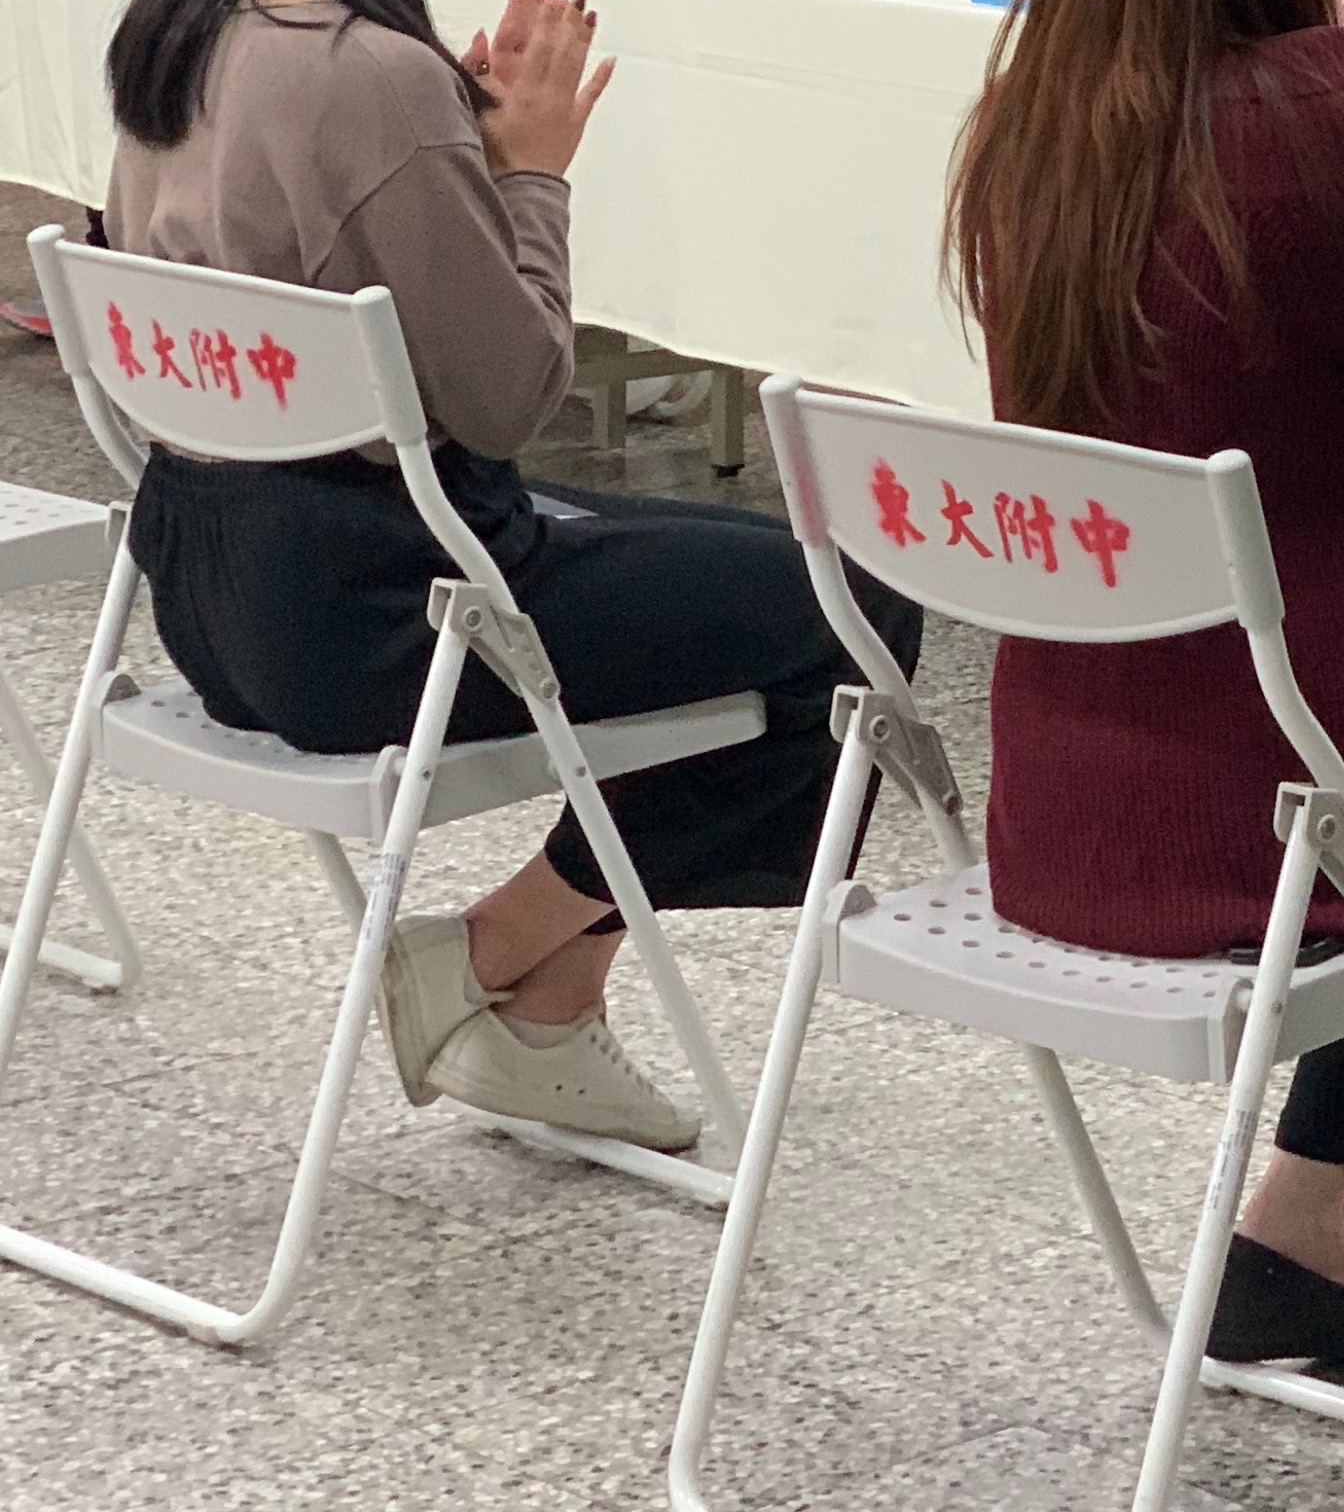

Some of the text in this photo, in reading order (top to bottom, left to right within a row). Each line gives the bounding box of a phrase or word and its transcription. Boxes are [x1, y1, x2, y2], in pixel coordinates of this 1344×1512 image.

[107, 301, 297, 410] 東大附中
[869, 457, 1131, 588] 東大附中
